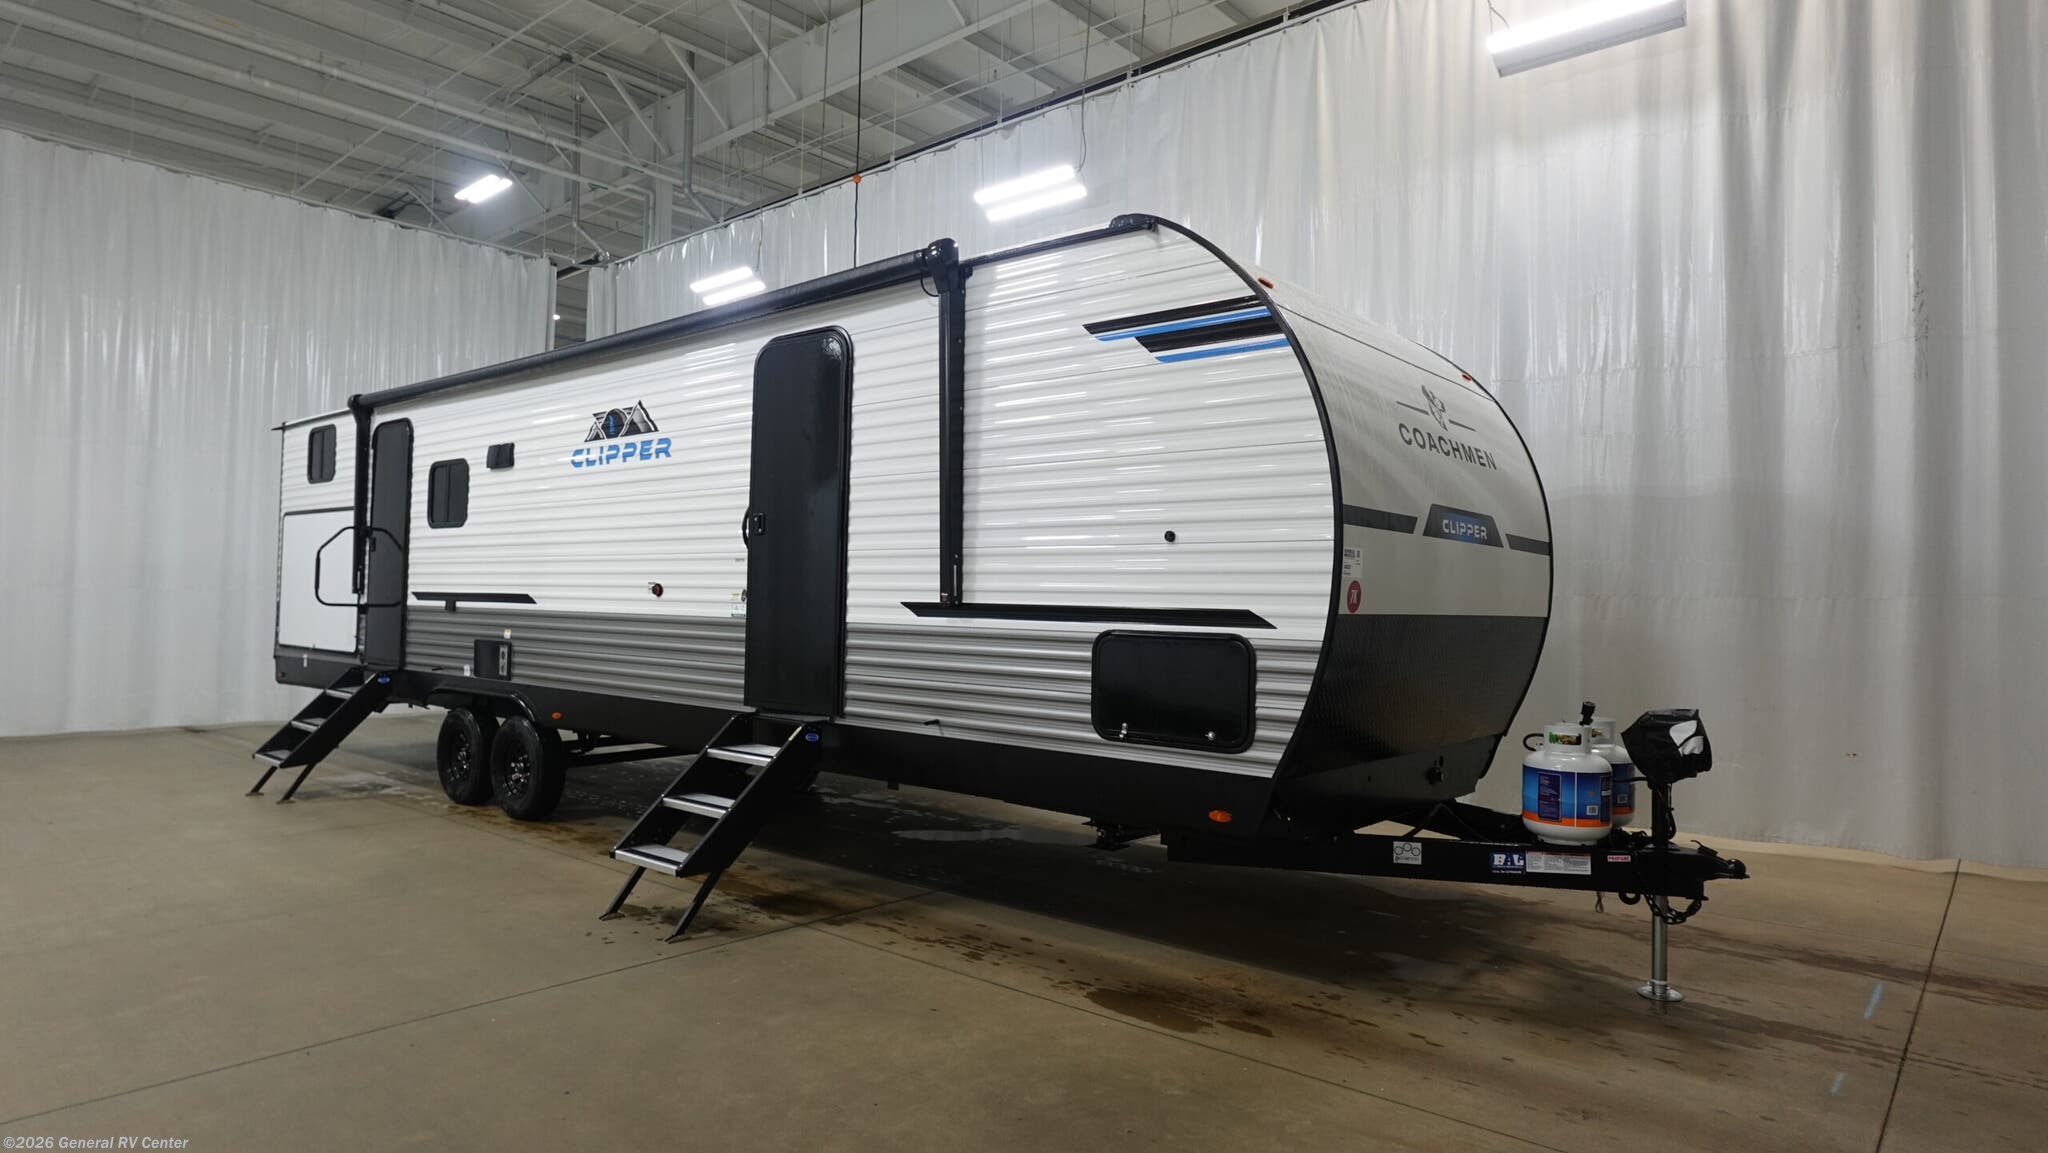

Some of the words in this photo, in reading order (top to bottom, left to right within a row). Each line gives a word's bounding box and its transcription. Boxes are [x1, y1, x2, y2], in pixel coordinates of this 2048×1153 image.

[571, 437, 671, 468] CLIPPER
[1399, 423, 1497, 470] COACHMEN
[1442, 519, 1488, 539] CLIPPER
